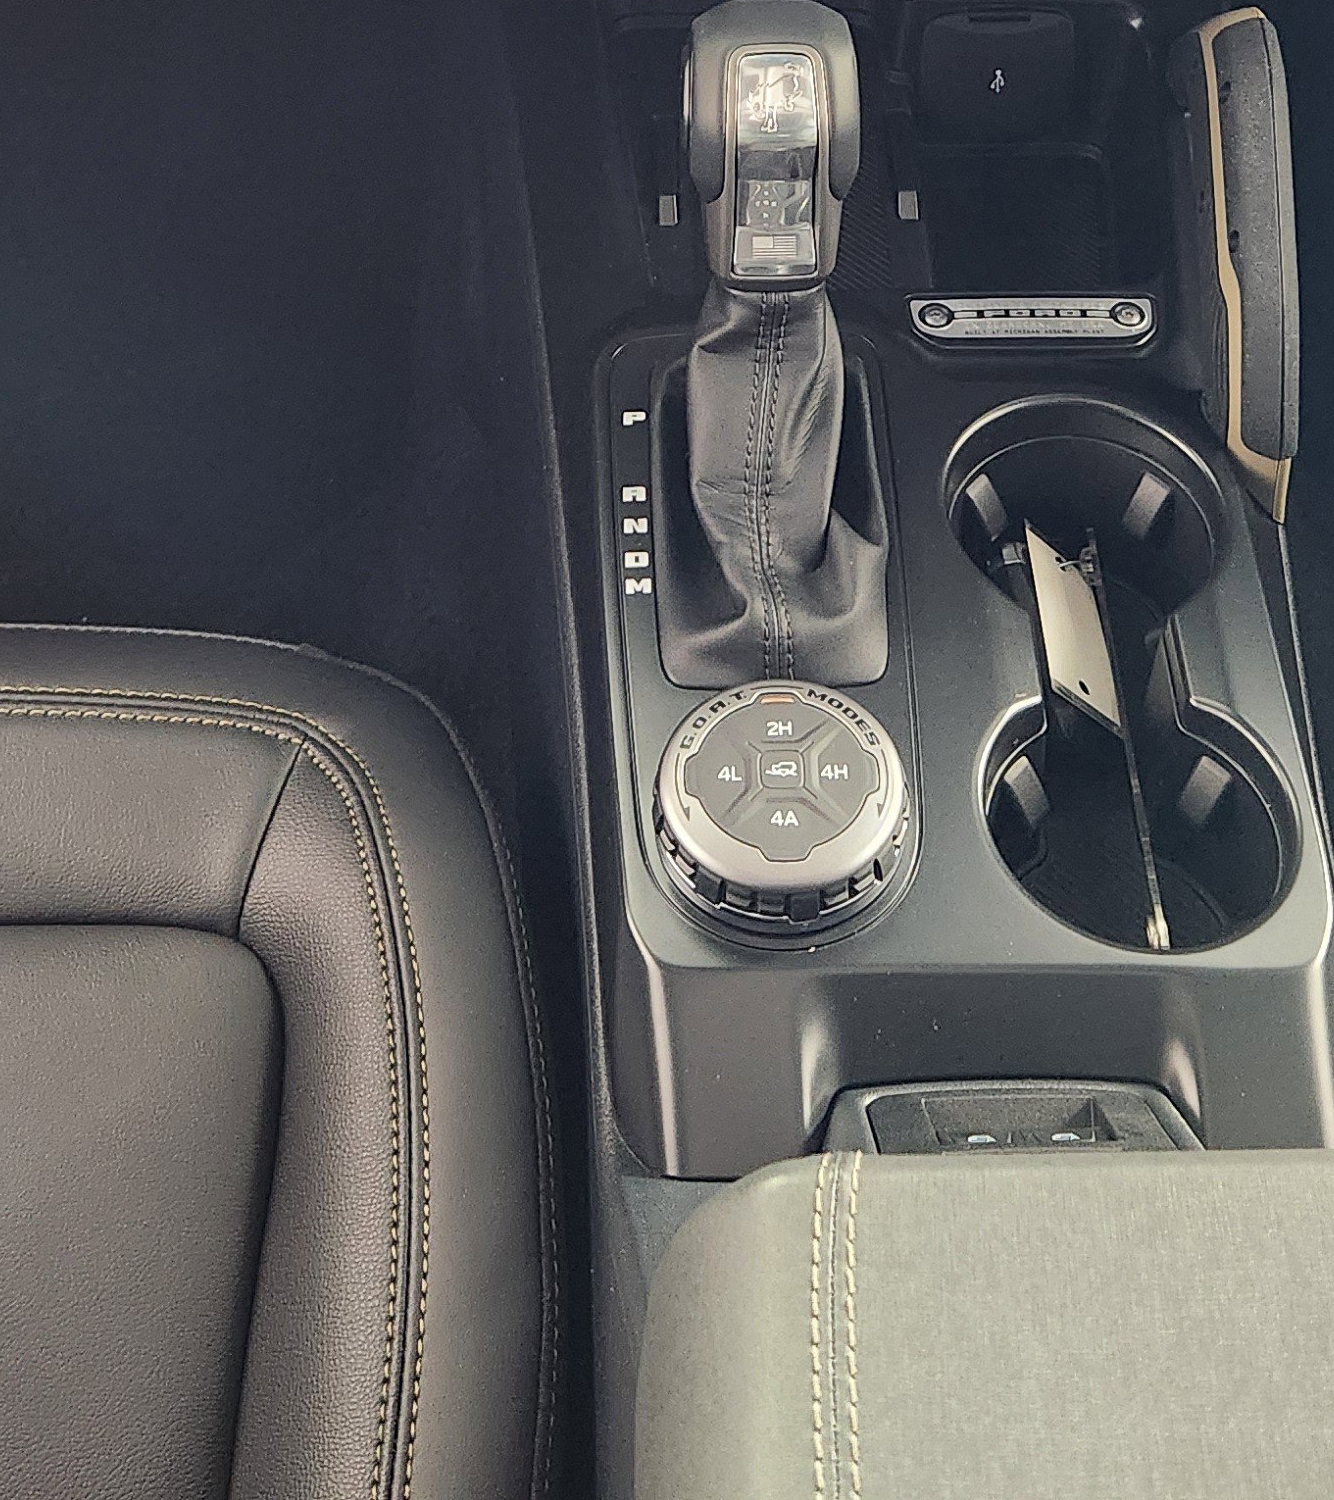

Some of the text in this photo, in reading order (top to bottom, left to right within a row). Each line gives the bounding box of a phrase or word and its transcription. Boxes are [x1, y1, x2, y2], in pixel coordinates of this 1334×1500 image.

[622, 411, 647, 426] P
[622, 485, 647, 502] R
[623, 518, 648, 534] N
[624, 551, 649, 568] D
[625, 578, 652, 595] M
[807, 688, 881, 746] MODES
[767, 721, 793, 736] 2H
[717, 766, 742, 782] 4L
[820, 764, 848, 780] 4H
[770, 810, 799, 827] 4A
